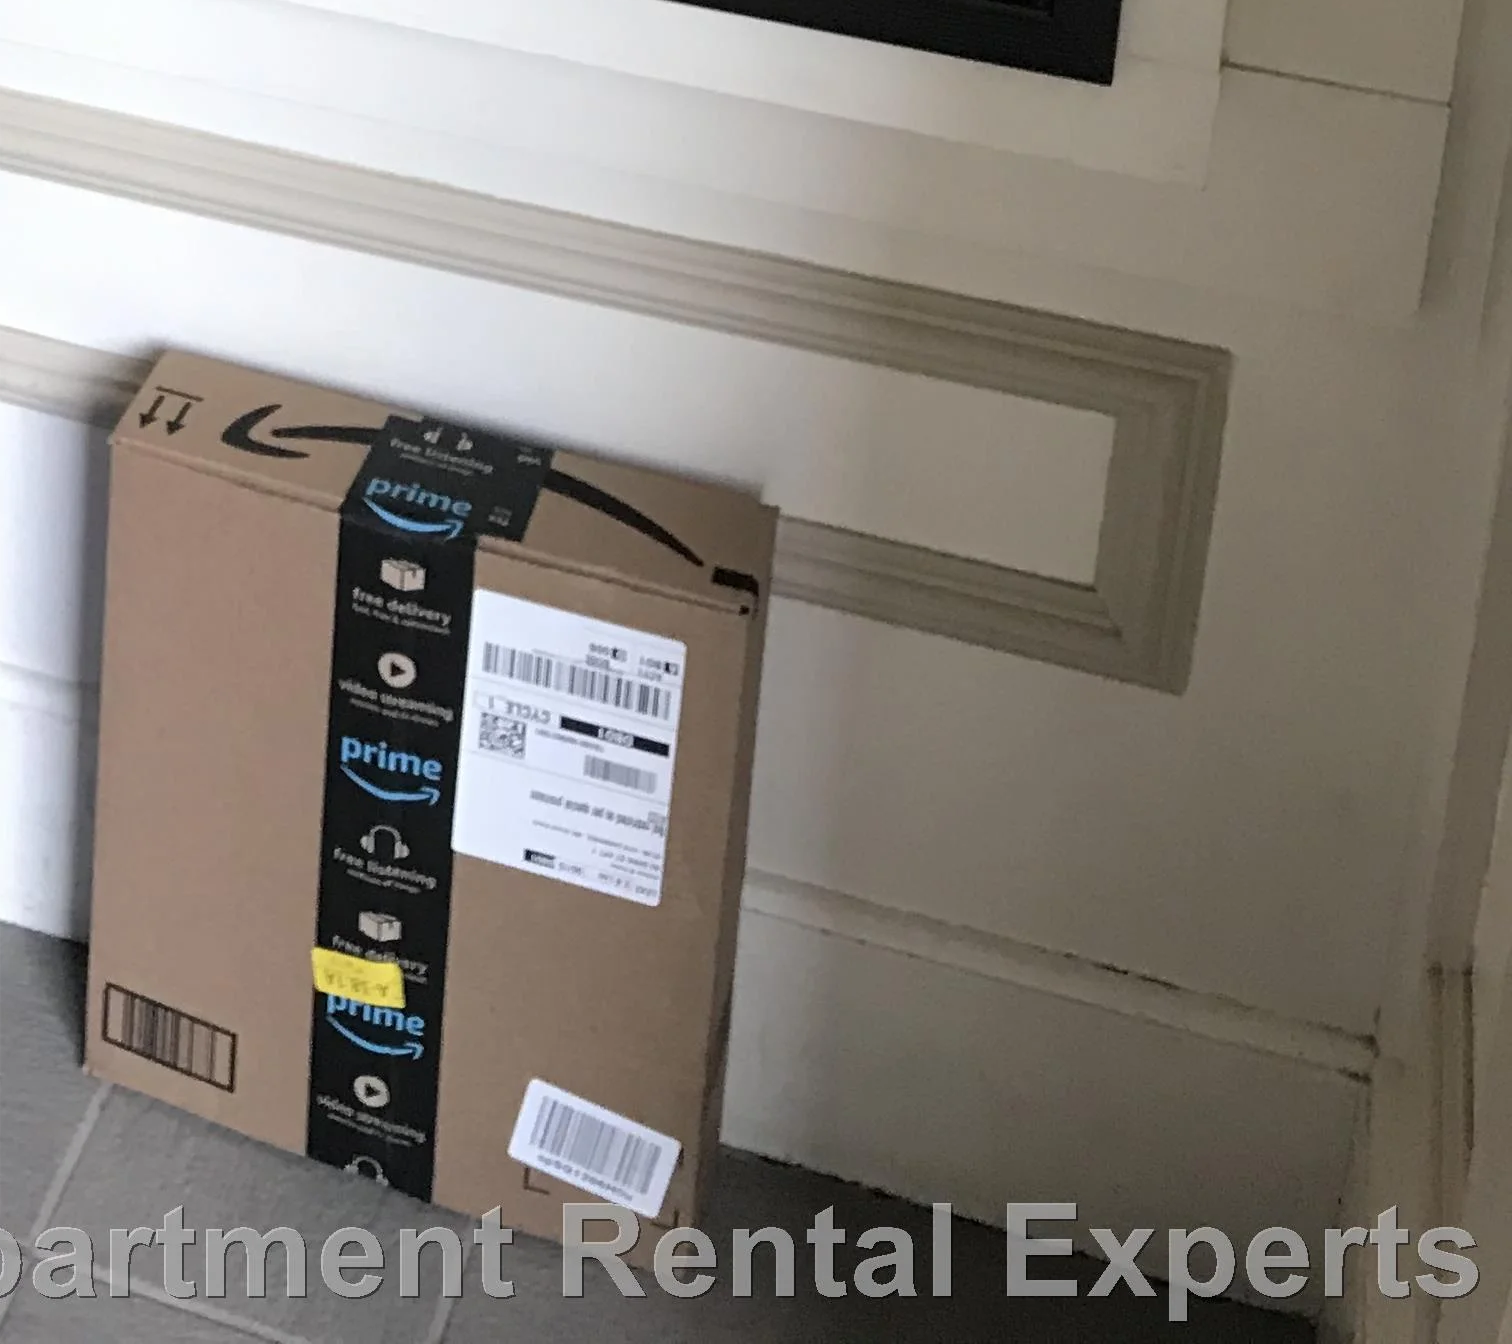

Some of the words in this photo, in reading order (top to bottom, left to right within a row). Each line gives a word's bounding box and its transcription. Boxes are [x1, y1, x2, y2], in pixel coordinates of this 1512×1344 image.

[365, 477, 473, 518] prime
[352, 586, 385, 609] free
[387, 599, 452, 627] delivery
[341, 735, 443, 781] prime
[327, 993, 425, 1037] prime
